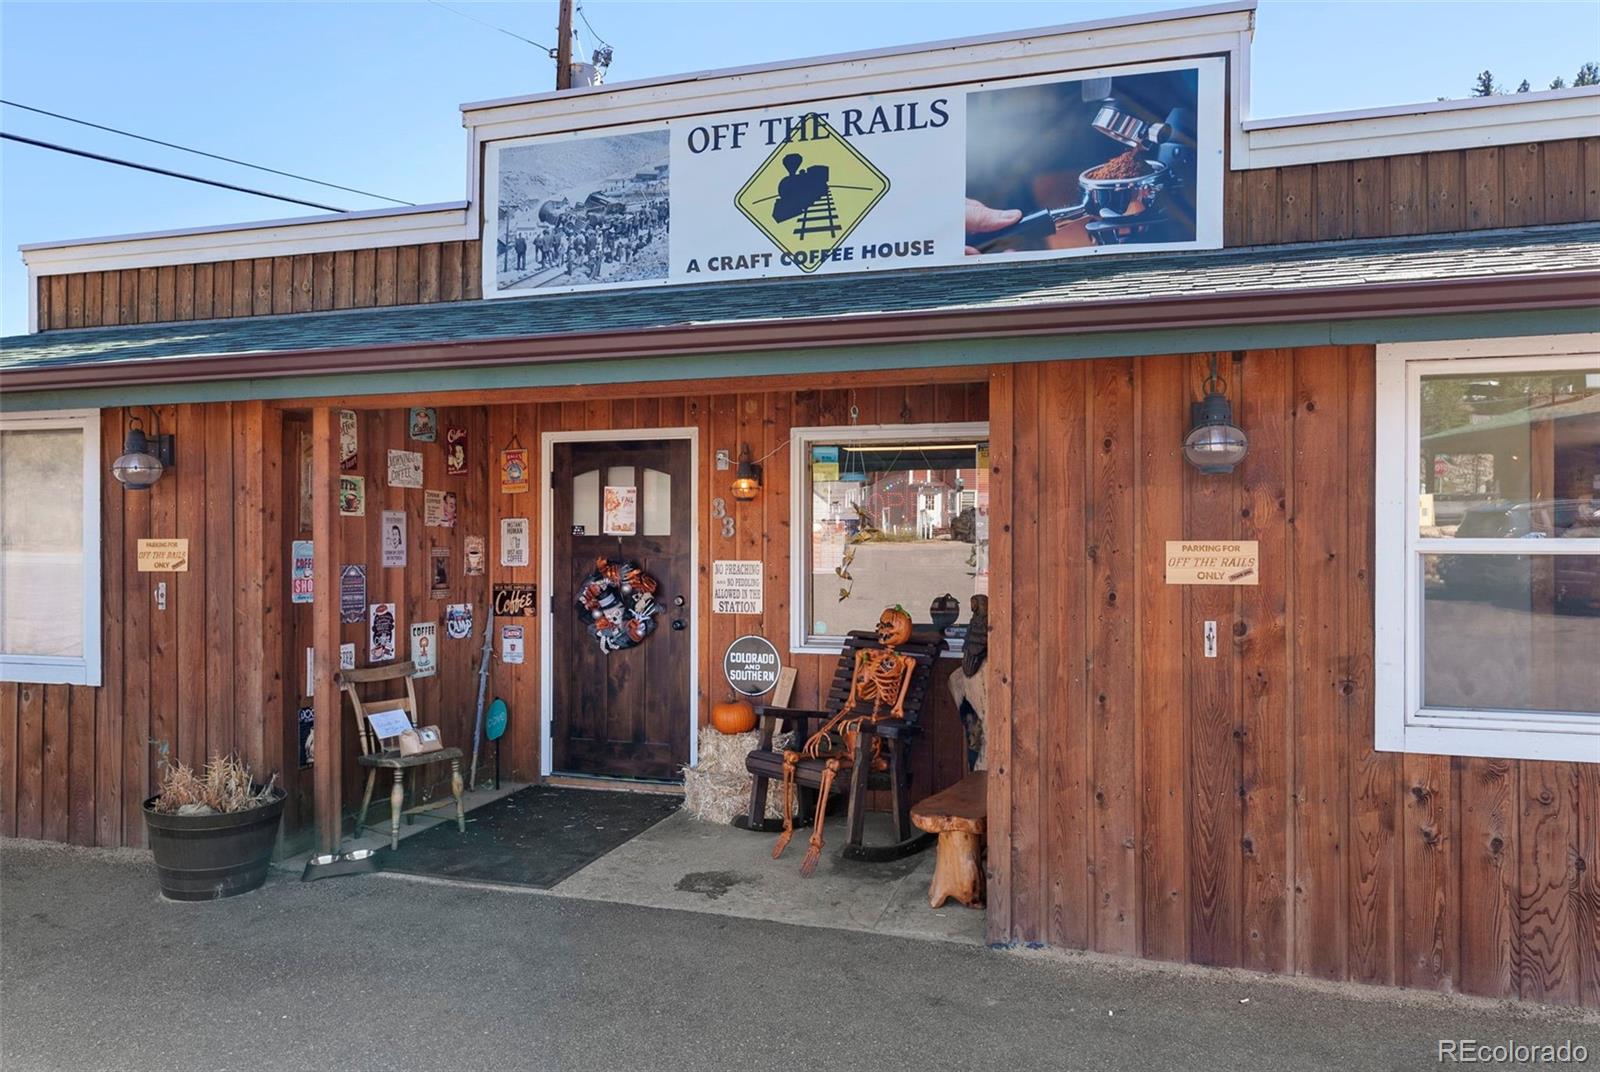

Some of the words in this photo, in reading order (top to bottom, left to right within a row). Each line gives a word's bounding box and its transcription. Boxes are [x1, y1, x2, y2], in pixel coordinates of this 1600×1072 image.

[687, 122, 749, 154] OFF
[759, 113, 831, 146] THE
[841, 98, 949, 138] RAILS
[686, 258, 701, 273] A
[707, 252, 773, 272] CRAFT
[780, 246, 854, 266] COFFEE
[861, 239, 935, 260] HOUSE
[1181, 544, 1221, 553] PARKING
[1222, 544, 1240, 553] FOR
[1167, 557, 1191, 568] OFF
[1193, 557, 1217, 568] THE
[1220, 557, 1256, 568] RAILS
[715, 563, 724, 575] NO
[725, 563, 760, 575] PREACHING
[1196, 571, 1226, 580] ONLY
[294, 579, 314, 593] SHO
[715, 589, 741, 599] ALLOWED
[741, 589, 749, 599] IN
[749, 589, 761, 599] THE
[718, 601, 756, 613] STATION
[412, 625, 435, 637] COFFEE
[730, 652, 775, 665] COLORADO
[730, 670, 775, 682] SOUTHERN
